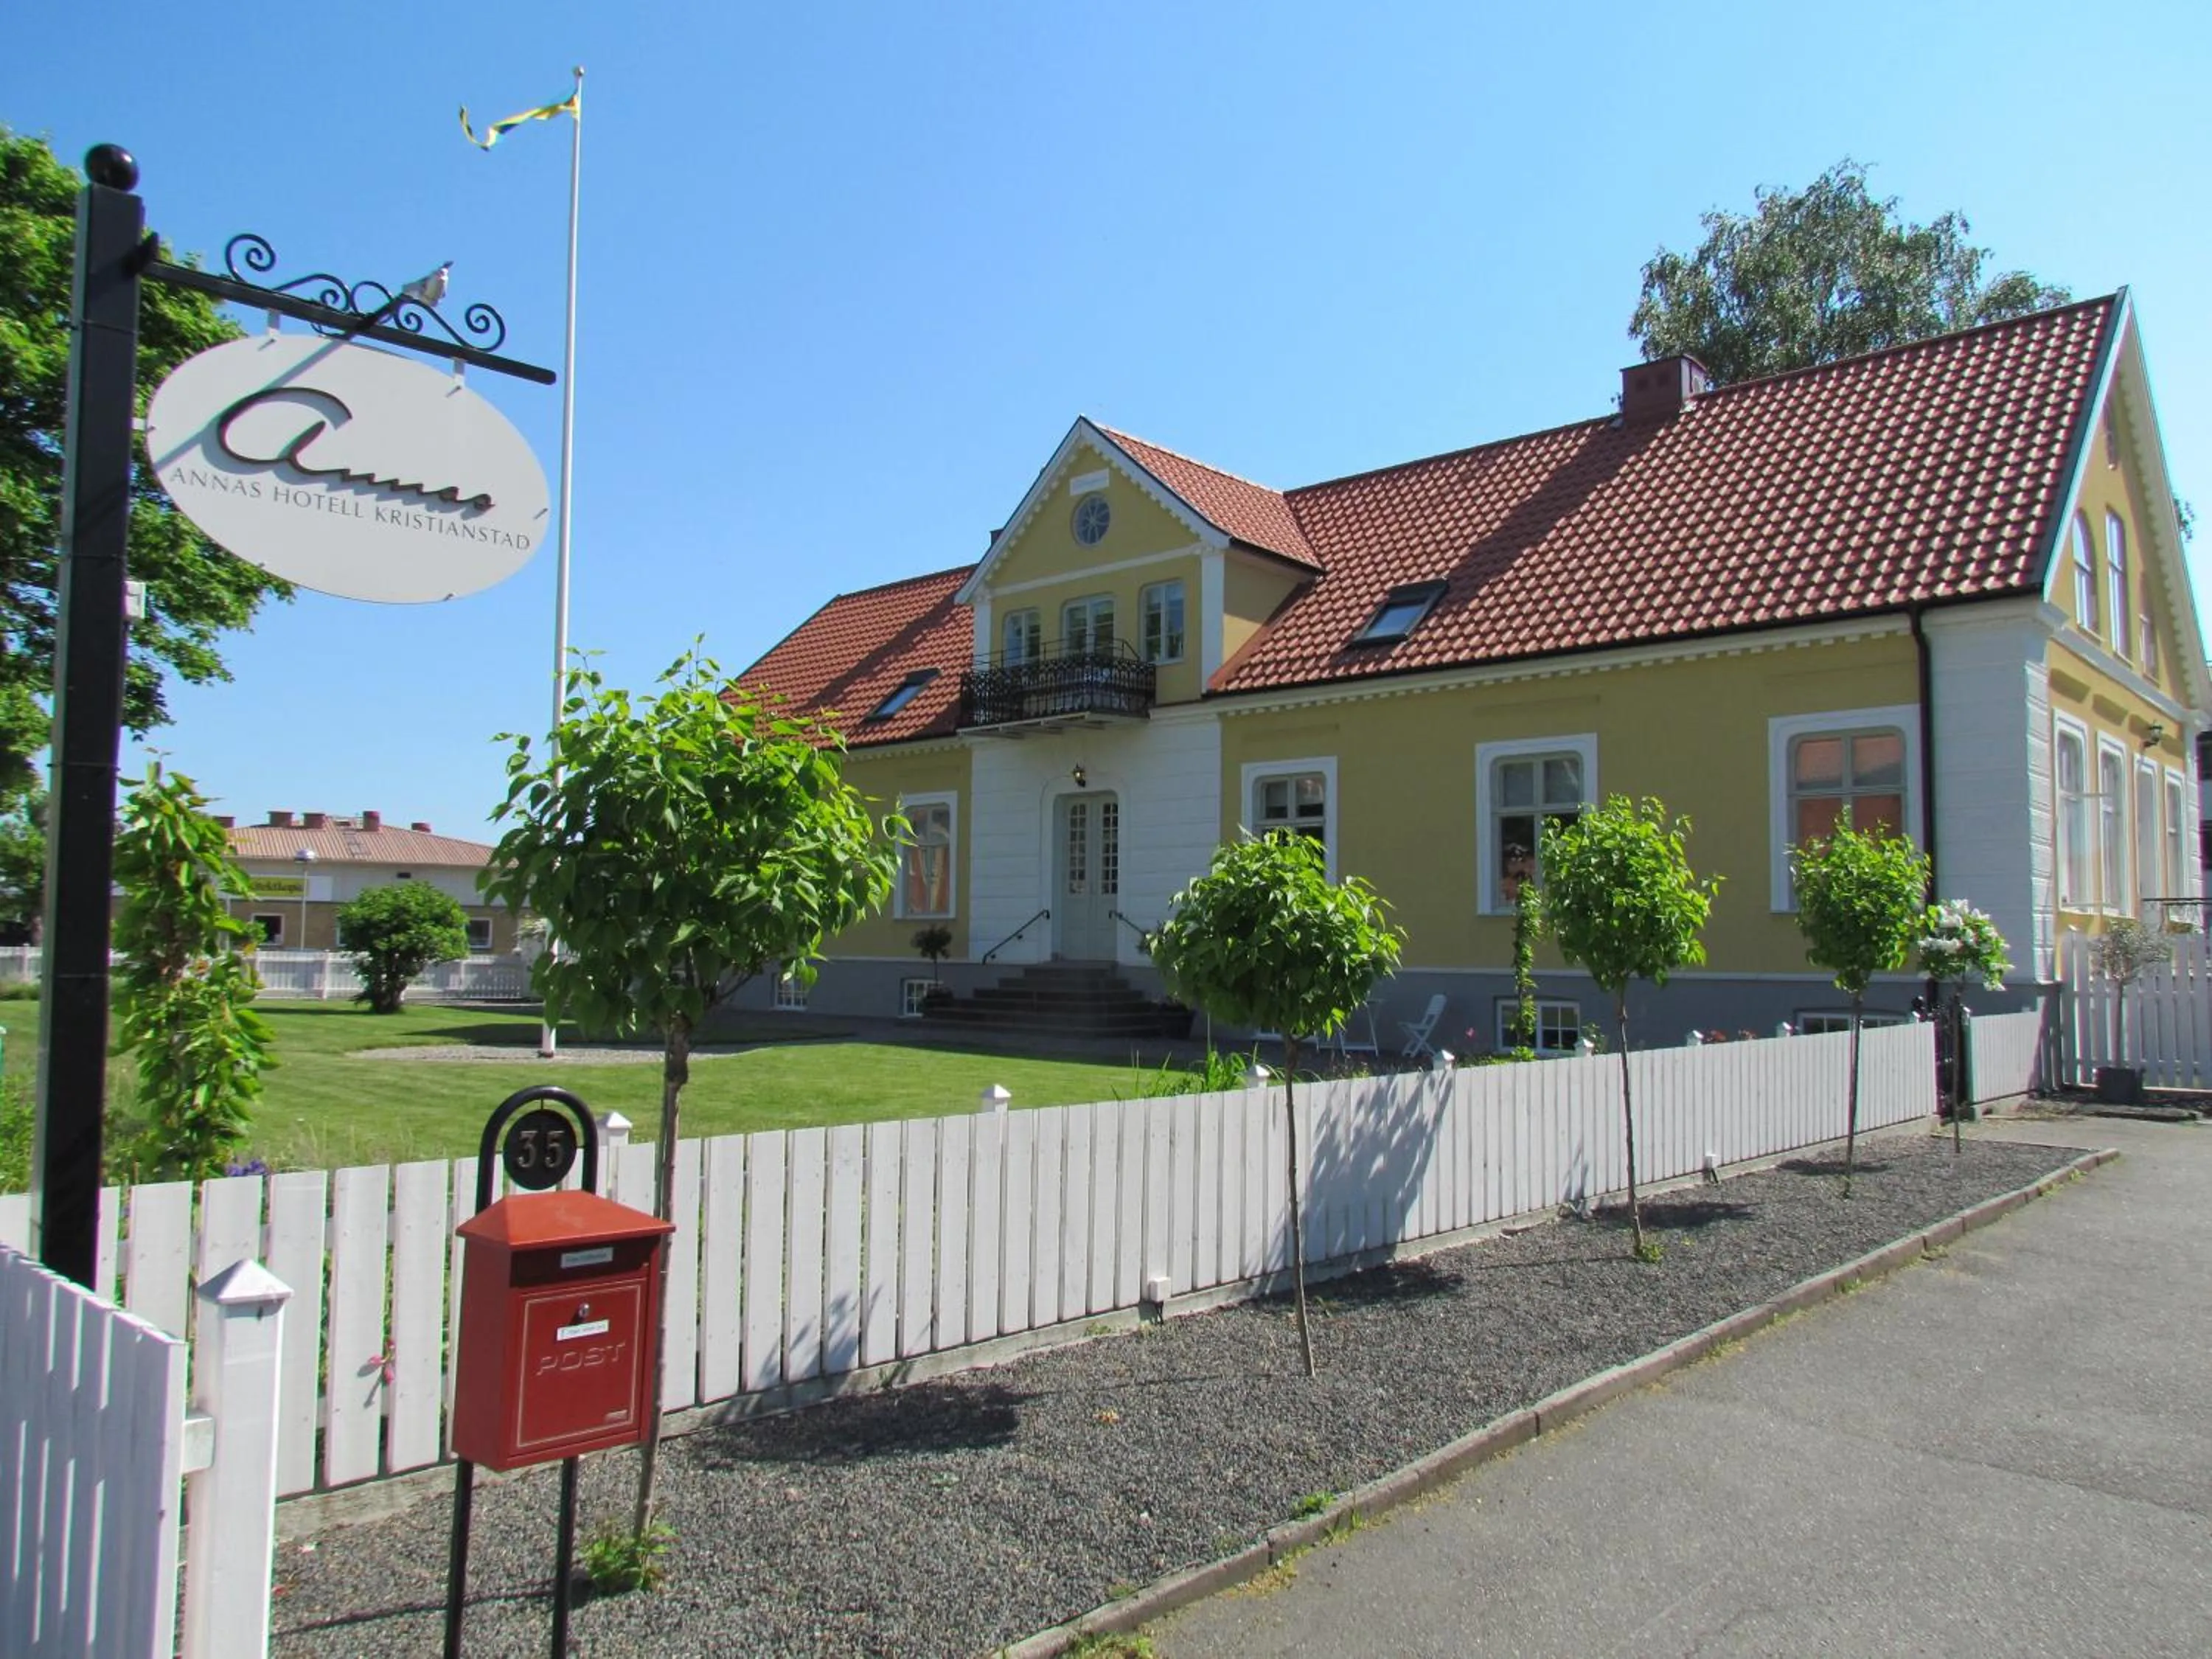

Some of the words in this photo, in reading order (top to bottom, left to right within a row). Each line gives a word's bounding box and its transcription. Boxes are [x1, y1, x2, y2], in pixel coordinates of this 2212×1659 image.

[170, 466, 261, 498] ANNAS
[274, 486, 364, 518] HOTELL
[375, 507, 530, 550] KRISTIANSTAD
[518, 1130, 565, 1168] 35
[537, 1341, 626, 1376] POST
